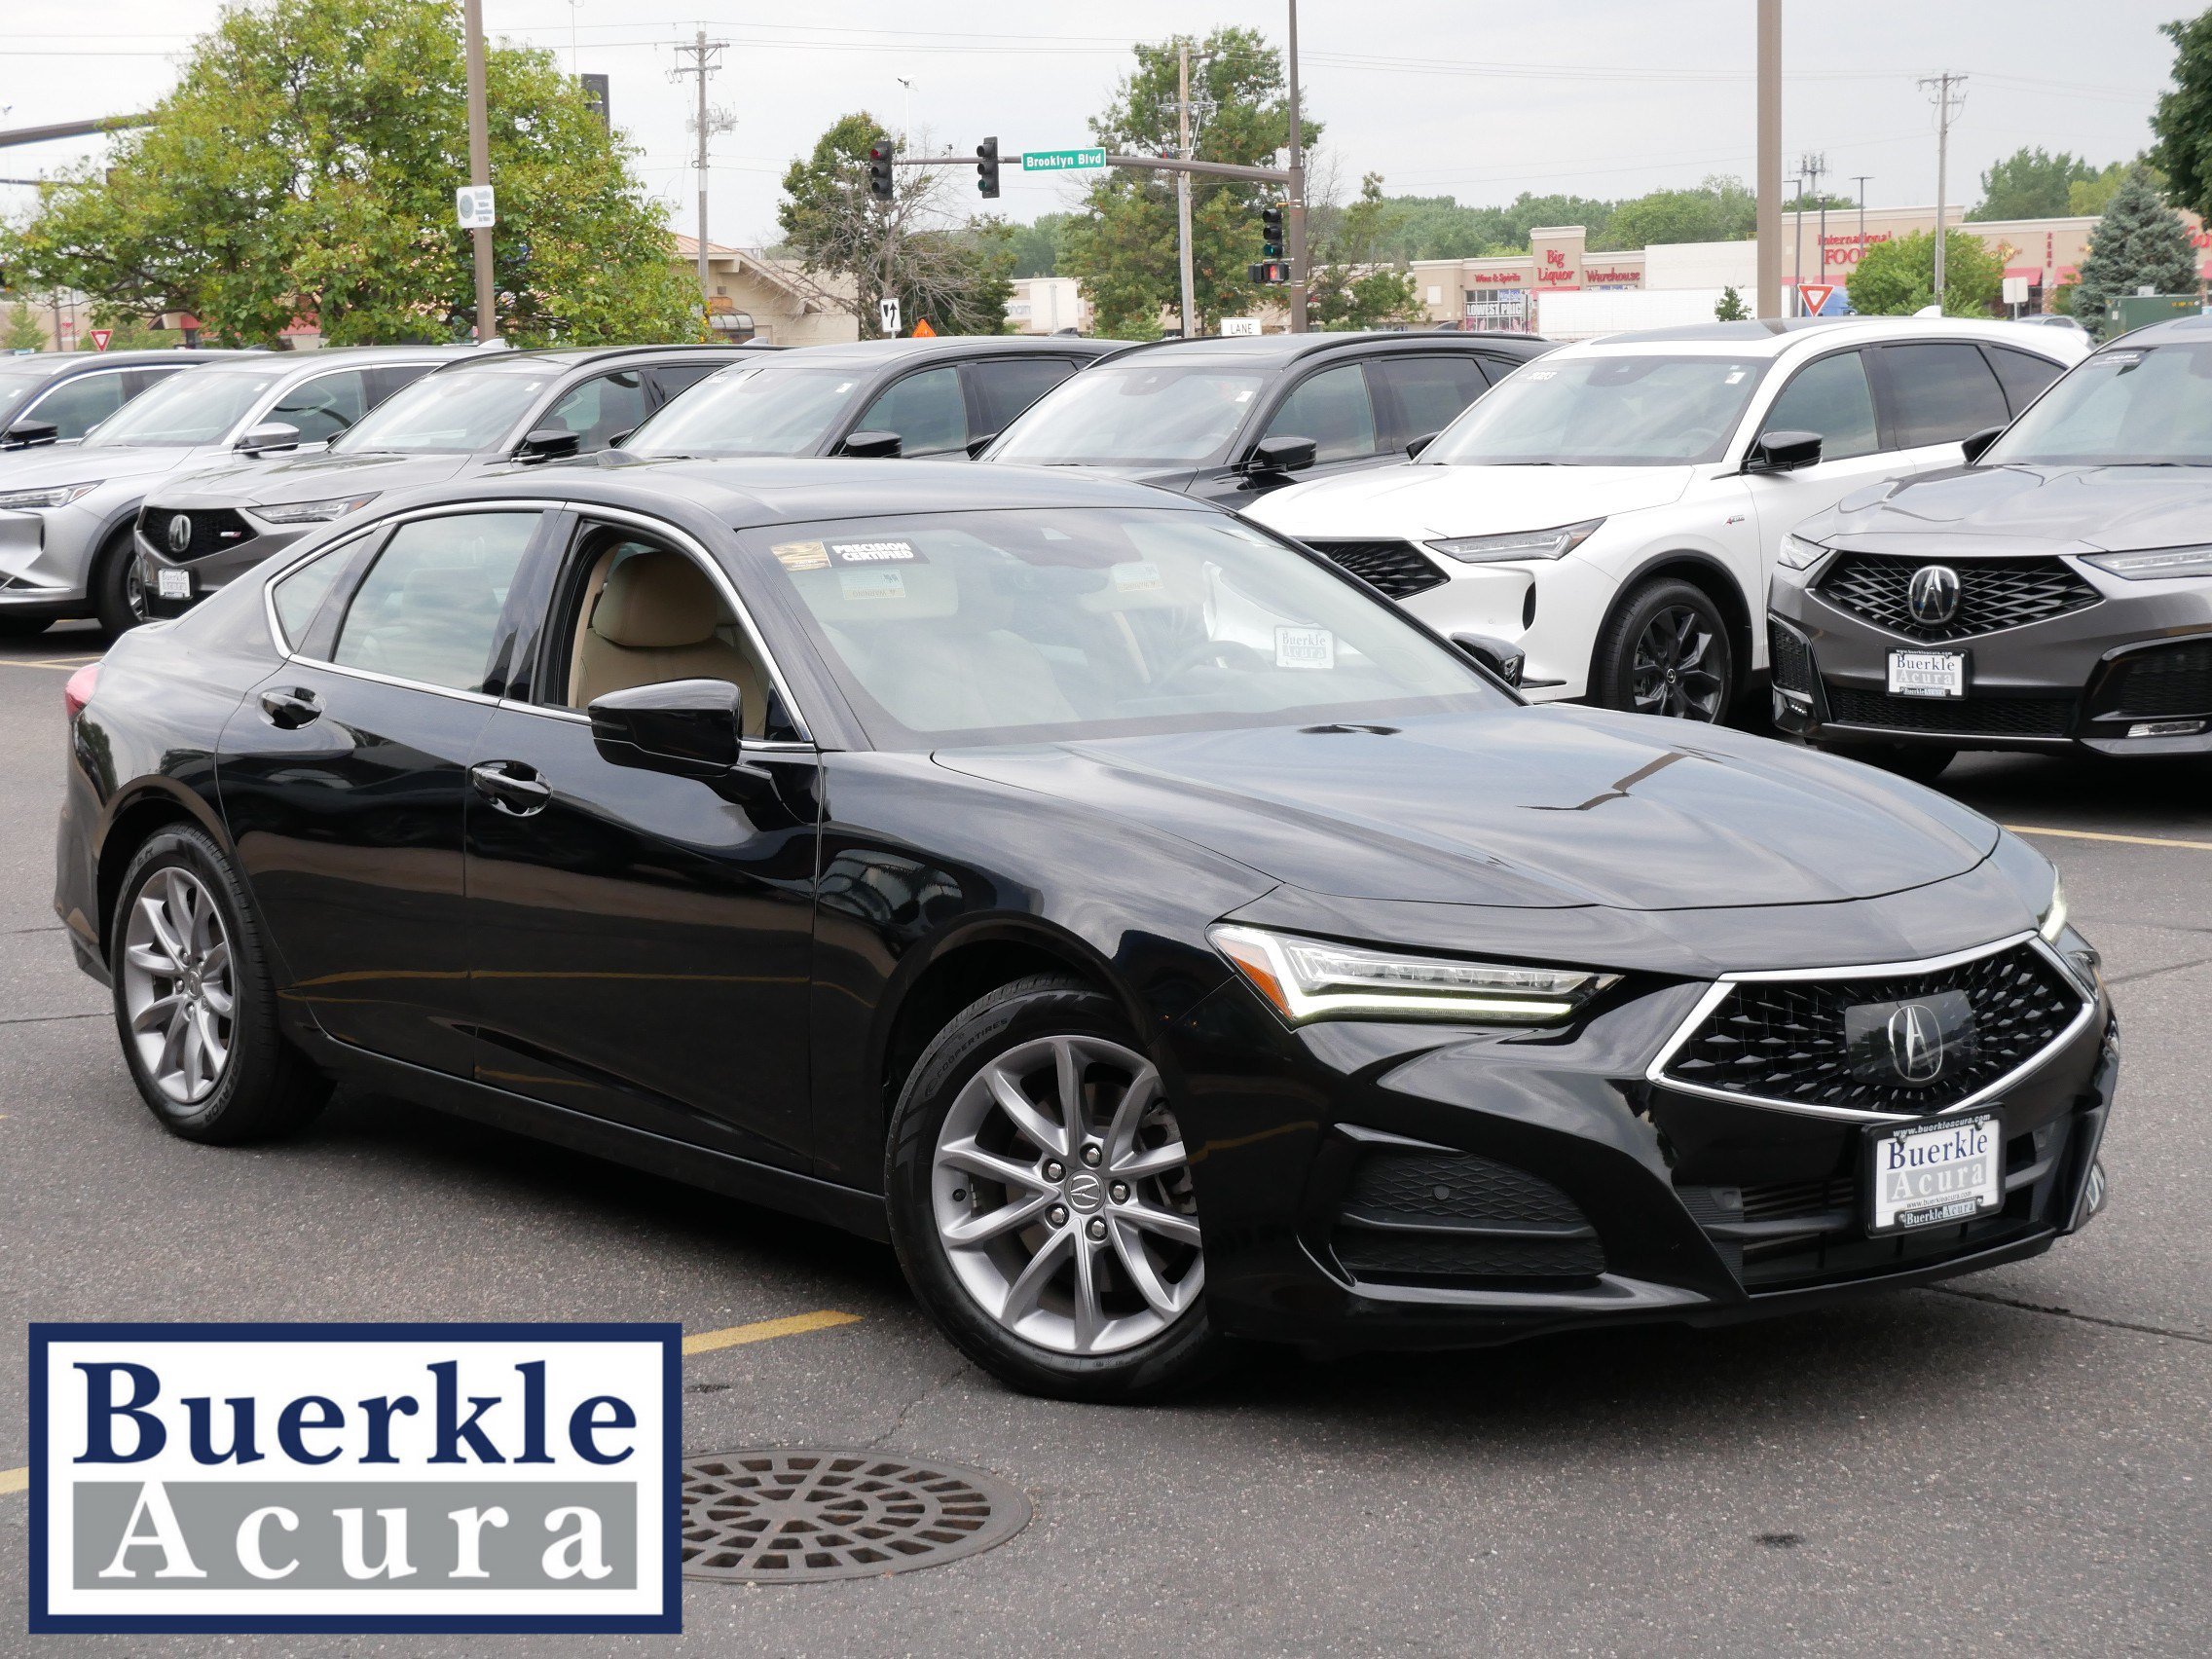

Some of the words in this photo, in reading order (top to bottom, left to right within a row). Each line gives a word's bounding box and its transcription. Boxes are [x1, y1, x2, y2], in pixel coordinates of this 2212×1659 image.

[1026, 155, 1074, 168] Brooklyn
[1078, 153, 1101, 165] Blvd
[1546, 249, 1566, 269] Big
[1474, 274, 1493, 282] Wine
[1499, 273, 1522, 284] Spirits
[1536, 267, 1575, 285] Liquor
[1585, 267, 1641, 282] Warehouse
[1466, 304, 1498, 316] LOWEST
[1230, 323, 1253, 334] LANE
[831, 542, 911, 554] PRECISION
[841, 551, 914, 562] CERTIFIED
[1281, 631, 1326, 646] Buerkle
[1897, 655, 1955, 671] Buerkle
[1899, 669, 1953, 684] Acura
[1893, 1113, 1991, 1138] www.buerkleacura.com
[1887, 1127, 1988, 1170] Buerkle
[1891, 1162, 1984, 1200] Acura
[1906, 1191, 1972, 1209] www.buerkleacura.com
